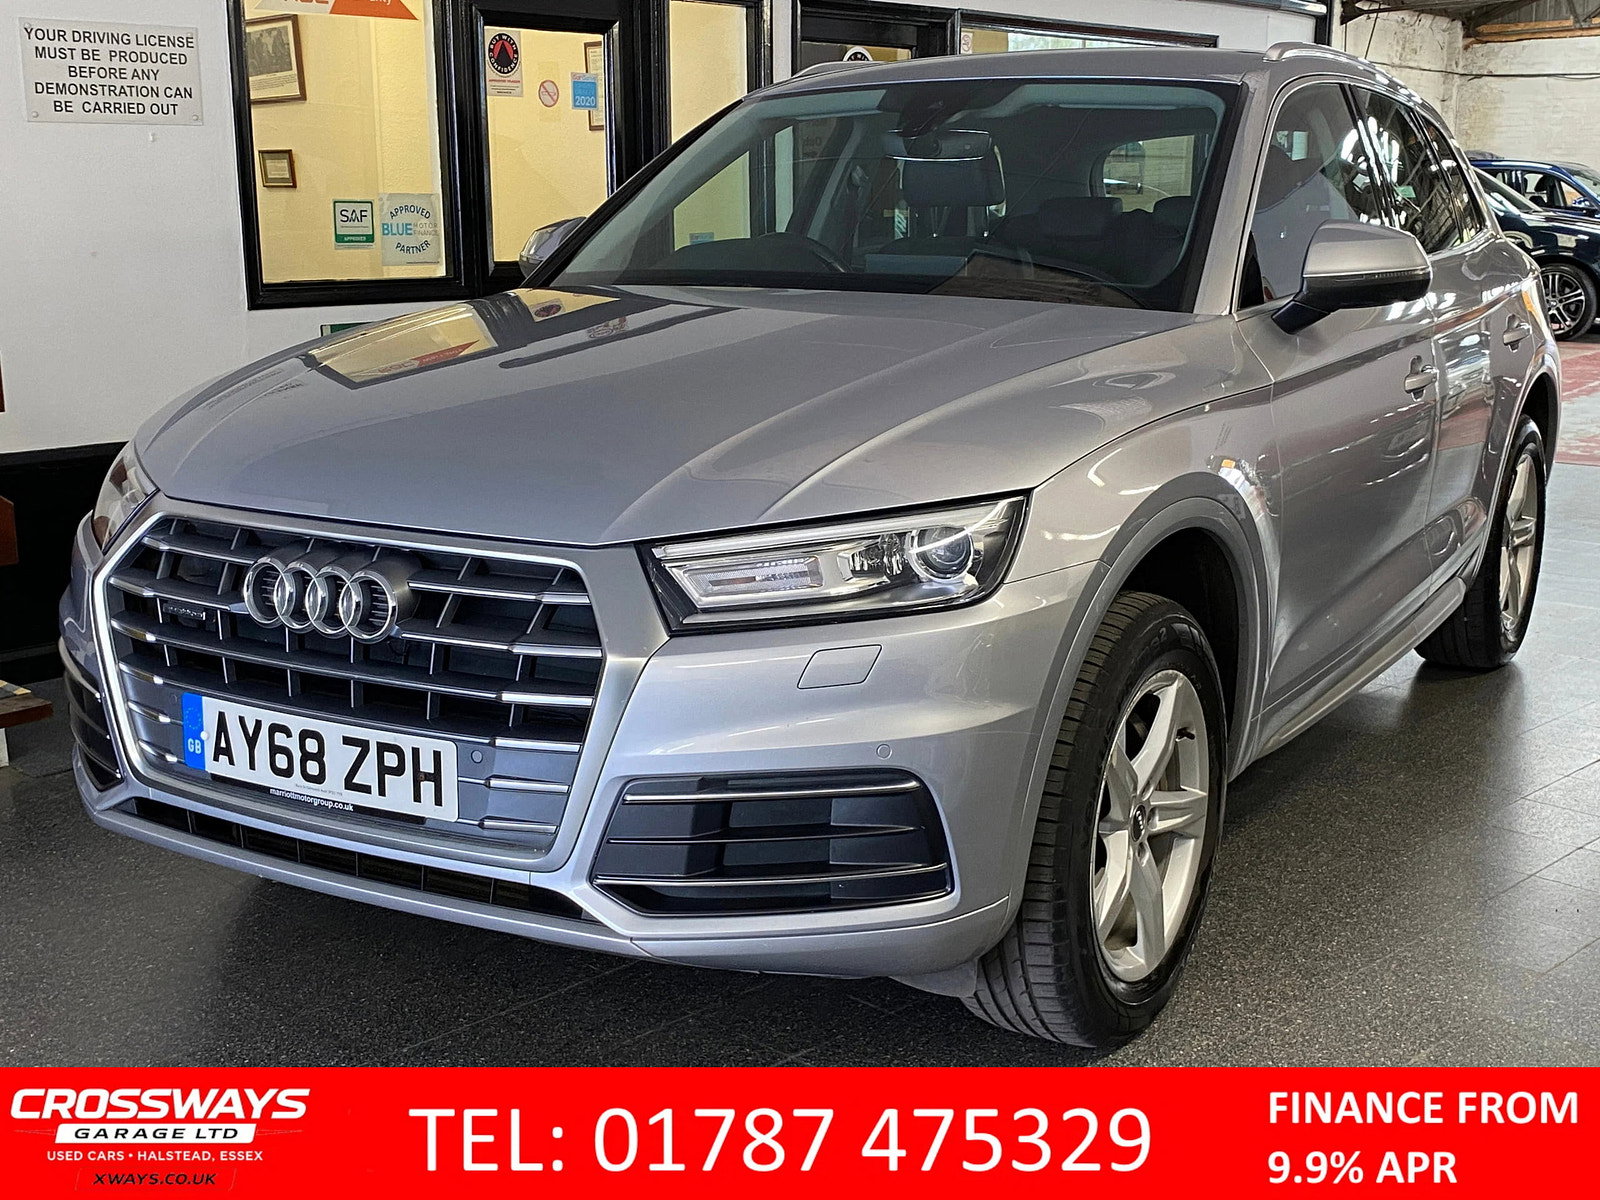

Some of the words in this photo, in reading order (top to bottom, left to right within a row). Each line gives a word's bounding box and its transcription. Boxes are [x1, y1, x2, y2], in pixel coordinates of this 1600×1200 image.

[24, 28, 68, 42] YOUR
[72, 30, 131, 45] DRIVING
[135, 34, 195, 48] LICENSE
[502, 35, 517, 50] WITH
[35, 46, 76, 61] MUST
[81, 49, 101, 61] BE
[109, 50, 188, 65] PRODUCED
[68, 66, 128, 80] BEFORE
[131, 68, 160, 81] ANY
[34, 82, 160, 98] DEMONSTRATION
[164, 86, 193, 99] CAN
[575, 95, 596, 106] 2020
[53, 101, 74, 113] BE
[82, 101, 146, 115] CARRIED
[149, 103, 178, 116] OUT
[340, 209, 368, 223] SAF
[389, 204, 431, 220] APPROVED
[381, 223, 413, 236] BLUE
[395, 240, 431, 254] PARTNER
[187, 738, 201, 754] GB
[212, 710, 327, 785] AY68
[342, 735, 444, 807] ZPH
[269, 788, 354, 811] marriottmotorgroup.co.uk
